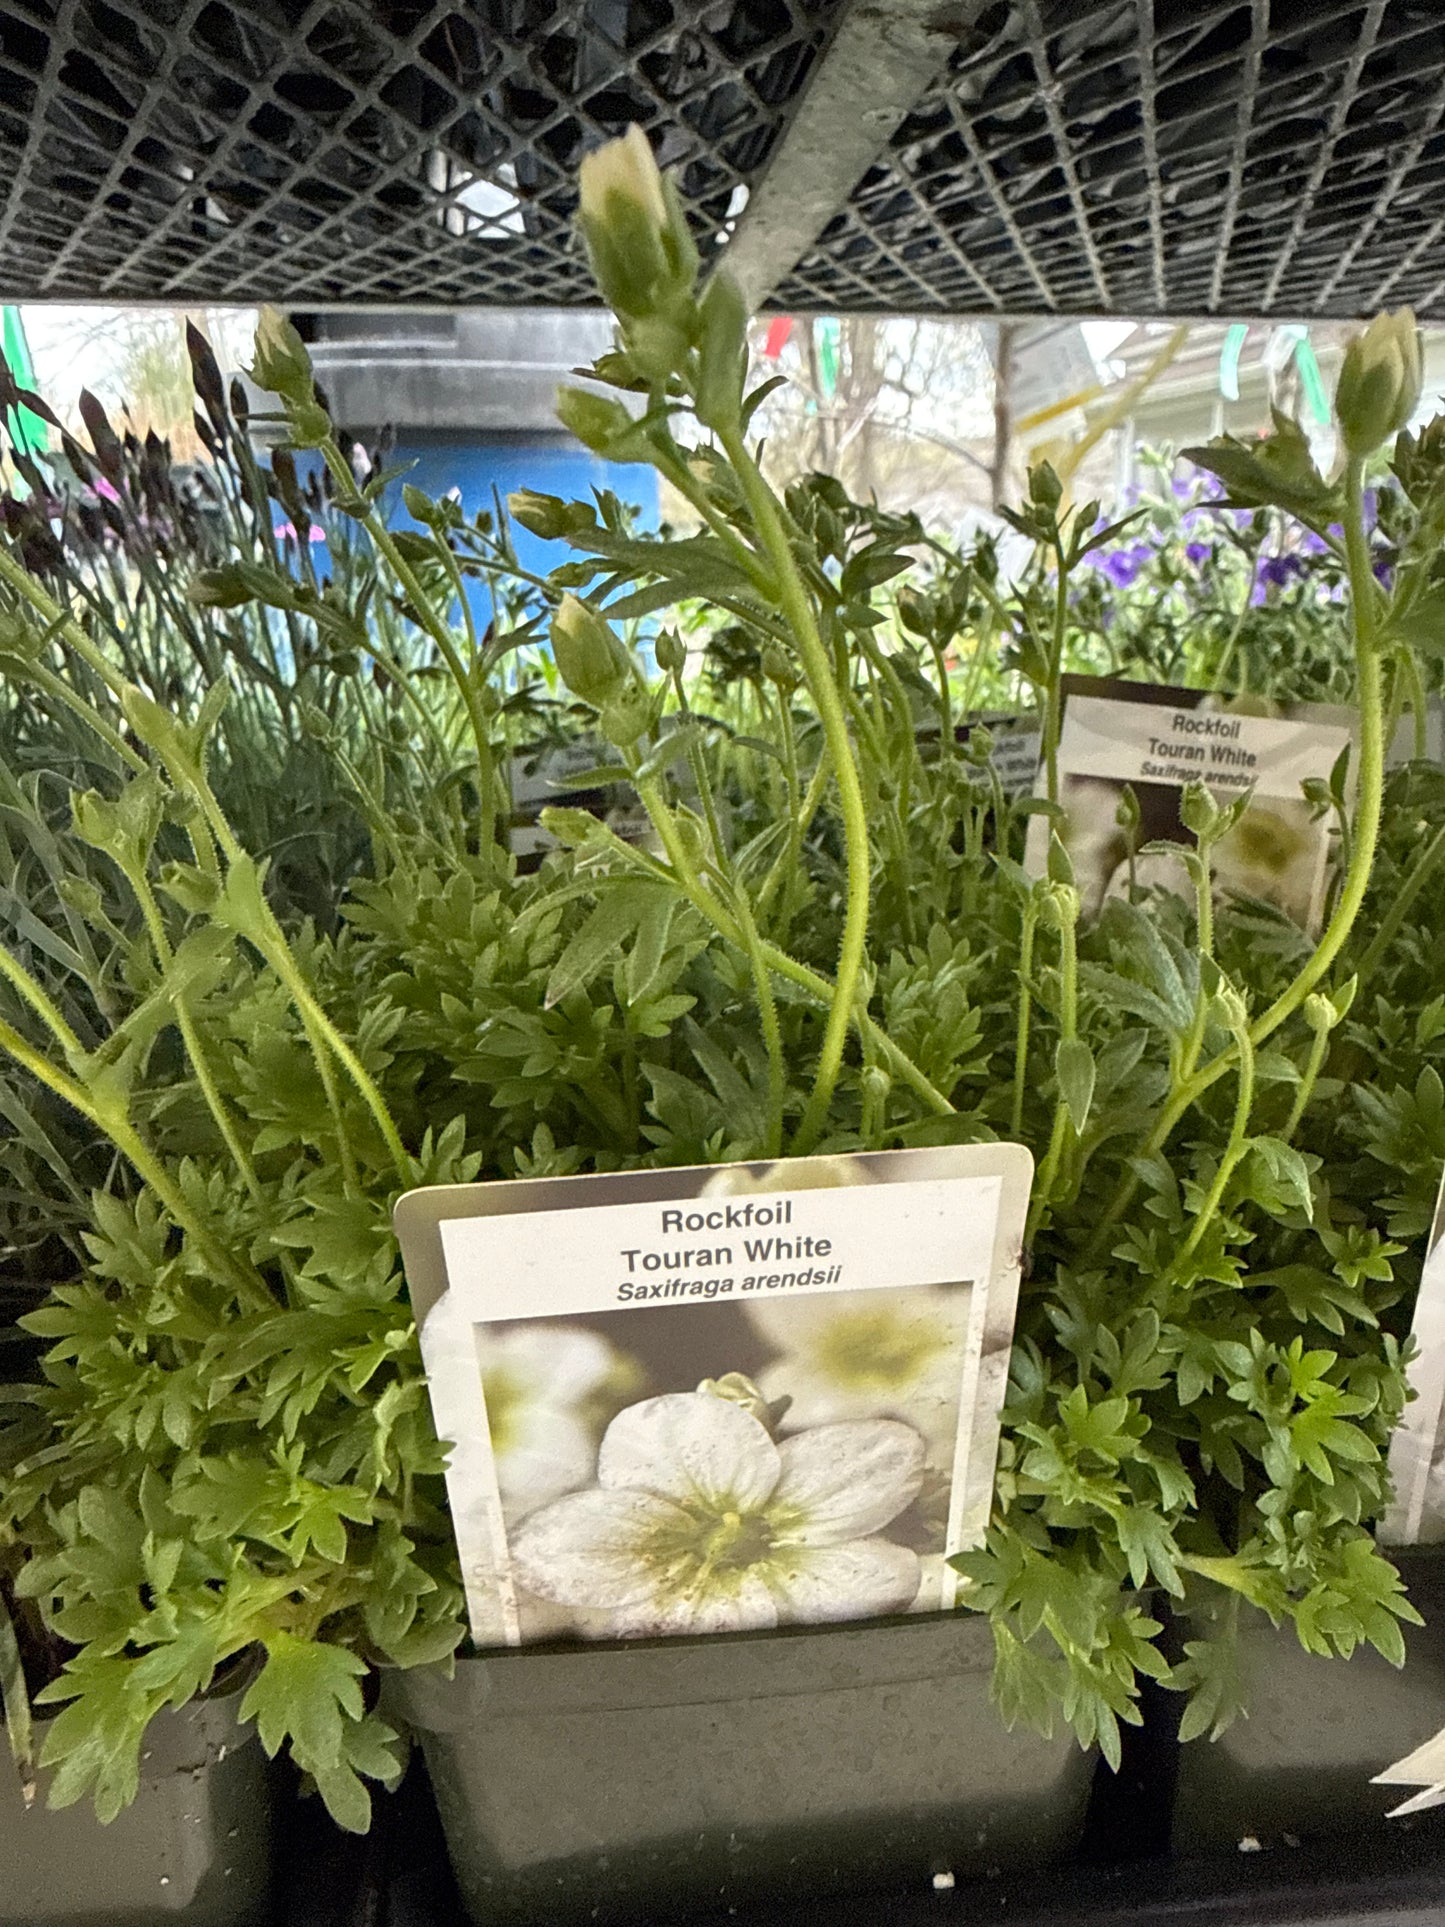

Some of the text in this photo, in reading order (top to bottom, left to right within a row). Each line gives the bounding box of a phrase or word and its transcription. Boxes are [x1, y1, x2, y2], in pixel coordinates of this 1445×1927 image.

[1172, 714, 1241, 738] Rockfoil
[1148, 737, 1257, 767] Touran White
[1205, 771, 1258, 787] arends
[662, 1200, 792, 1233] Rockfoil
[620, 1236, 832, 1272] Touran White
[617, 1265, 842, 1301] Saxifraga arendsii
